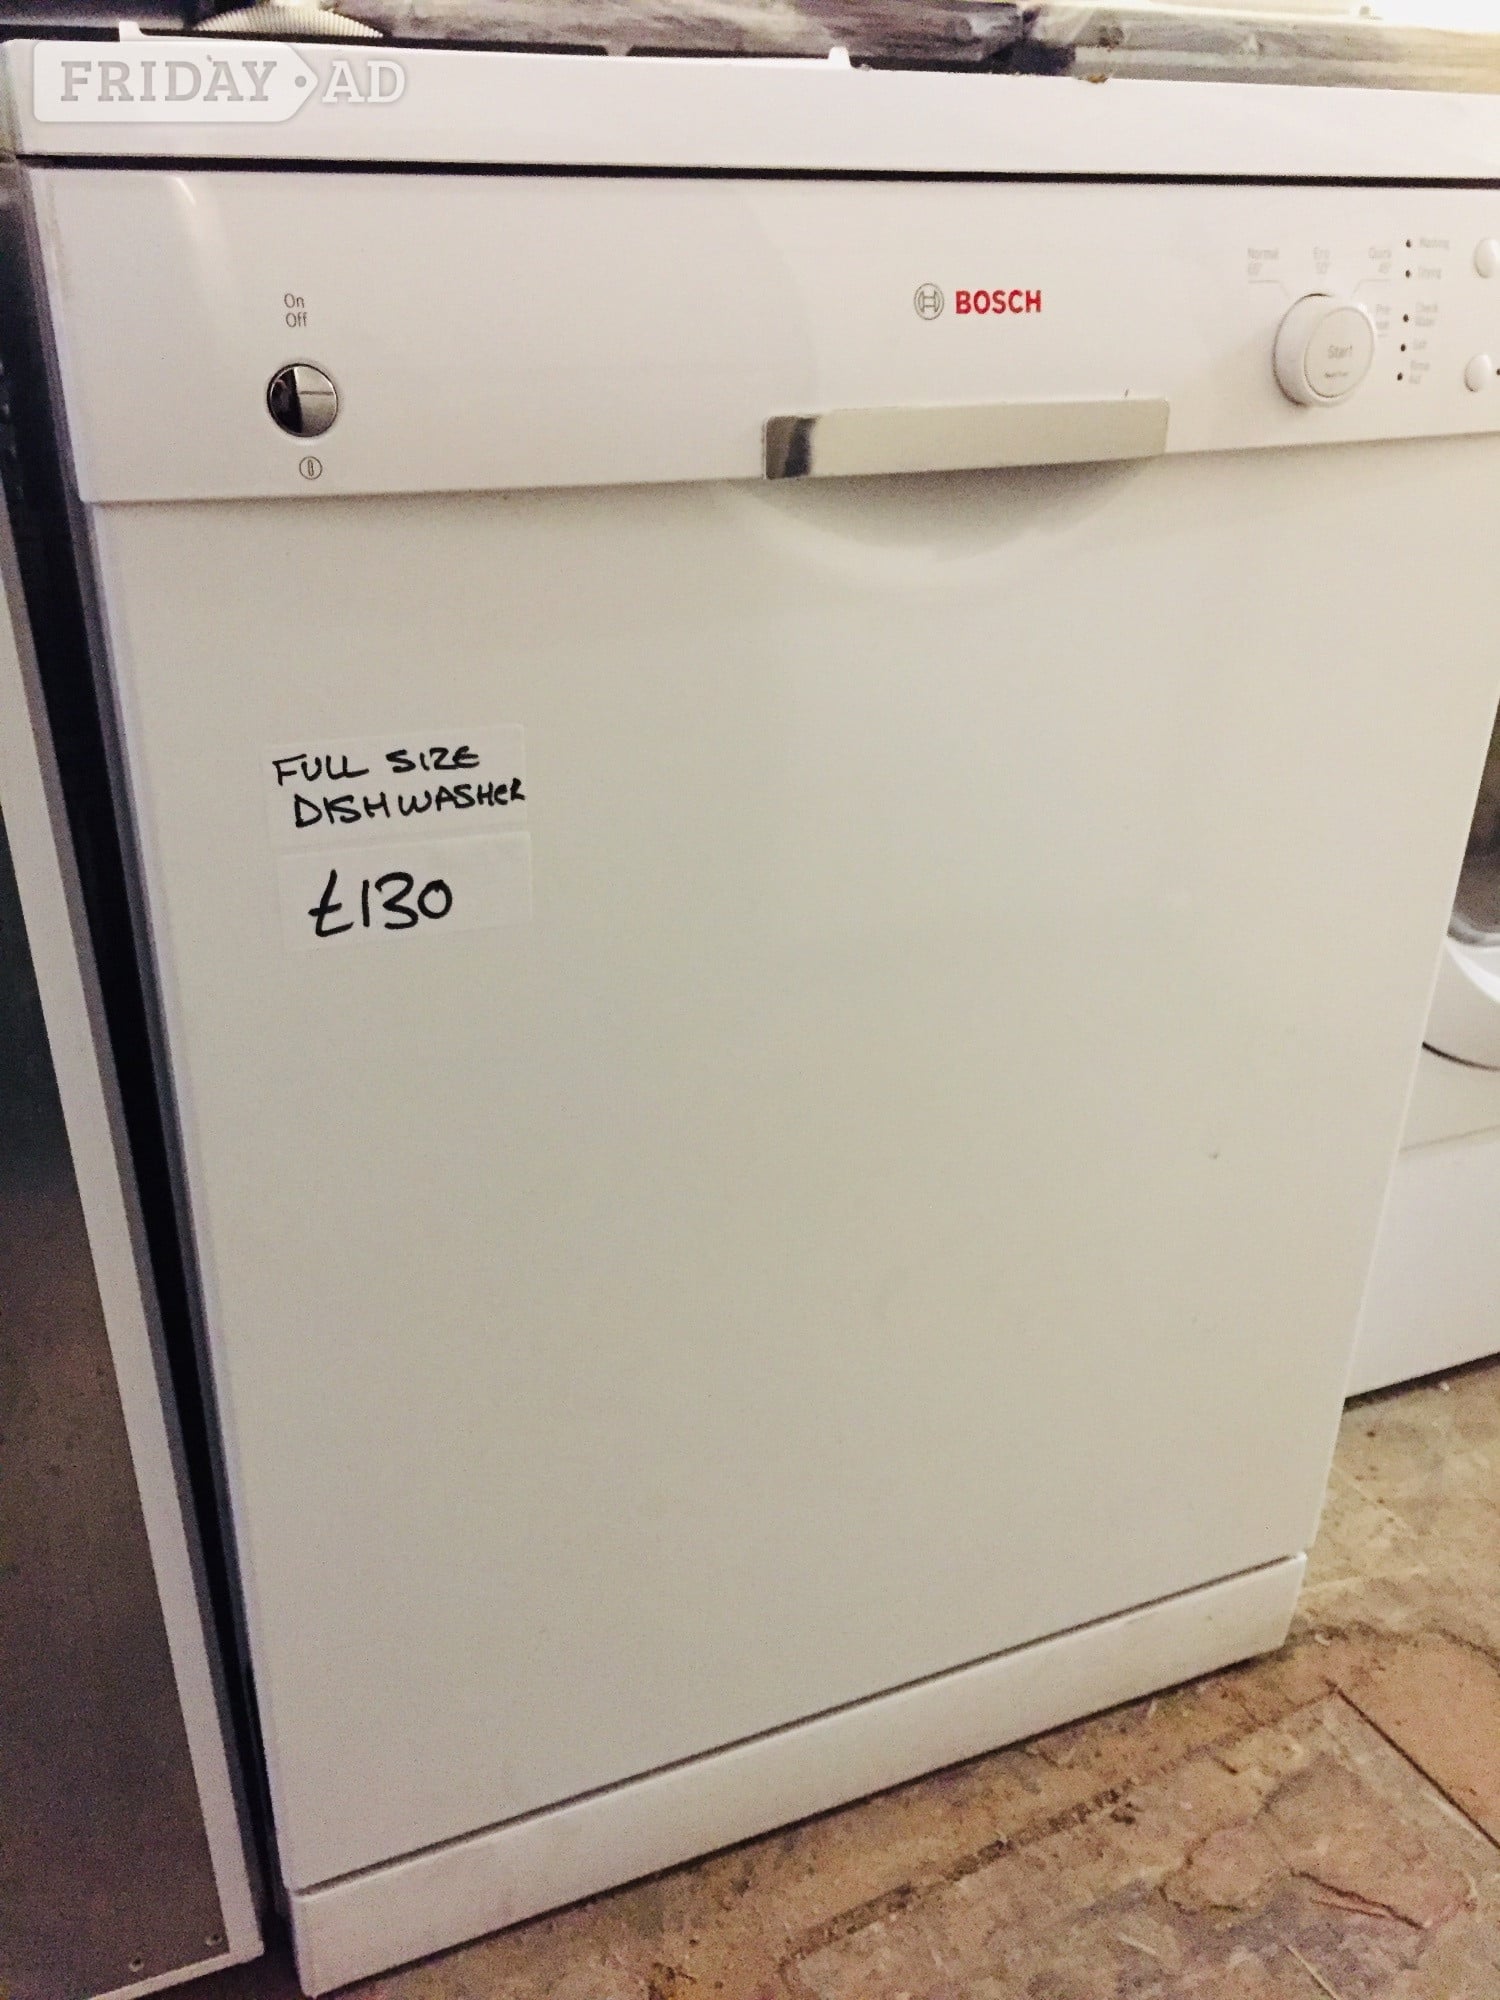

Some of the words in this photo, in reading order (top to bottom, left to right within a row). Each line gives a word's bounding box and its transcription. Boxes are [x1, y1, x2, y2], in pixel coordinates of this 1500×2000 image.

[284, 293, 305, 309] On
[955, 289, 1042, 315] BOSCH
[285, 311, 307, 328] Off
[272, 753, 370, 786] FULL
[385, 745, 480, 773] SIZE
[307, 868, 453, 938] £130
